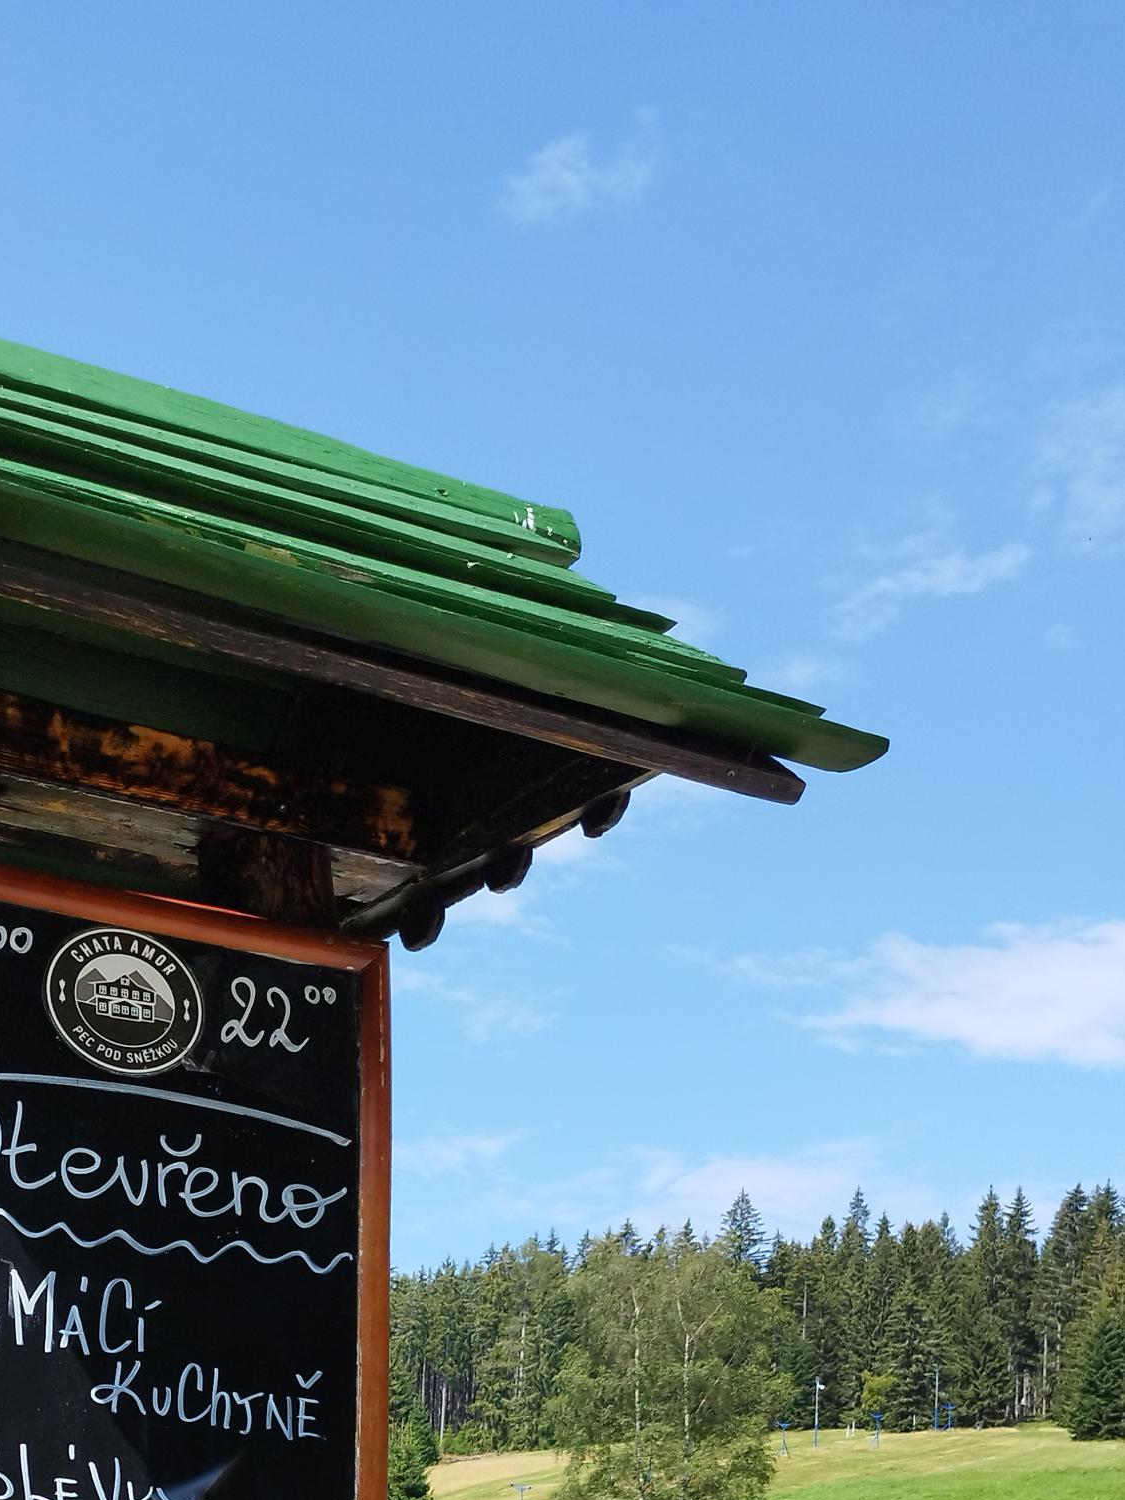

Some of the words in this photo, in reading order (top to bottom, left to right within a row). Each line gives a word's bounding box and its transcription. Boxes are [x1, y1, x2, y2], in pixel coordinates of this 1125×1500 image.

[70, 935, 123, 963] CHATA
[129, 939, 177, 977] AMOR
[72, 1024, 96, 1048] PEC
[96, 1043, 122, 1062] POD
[126, 1038, 178, 1064] SNĚŽKOU
